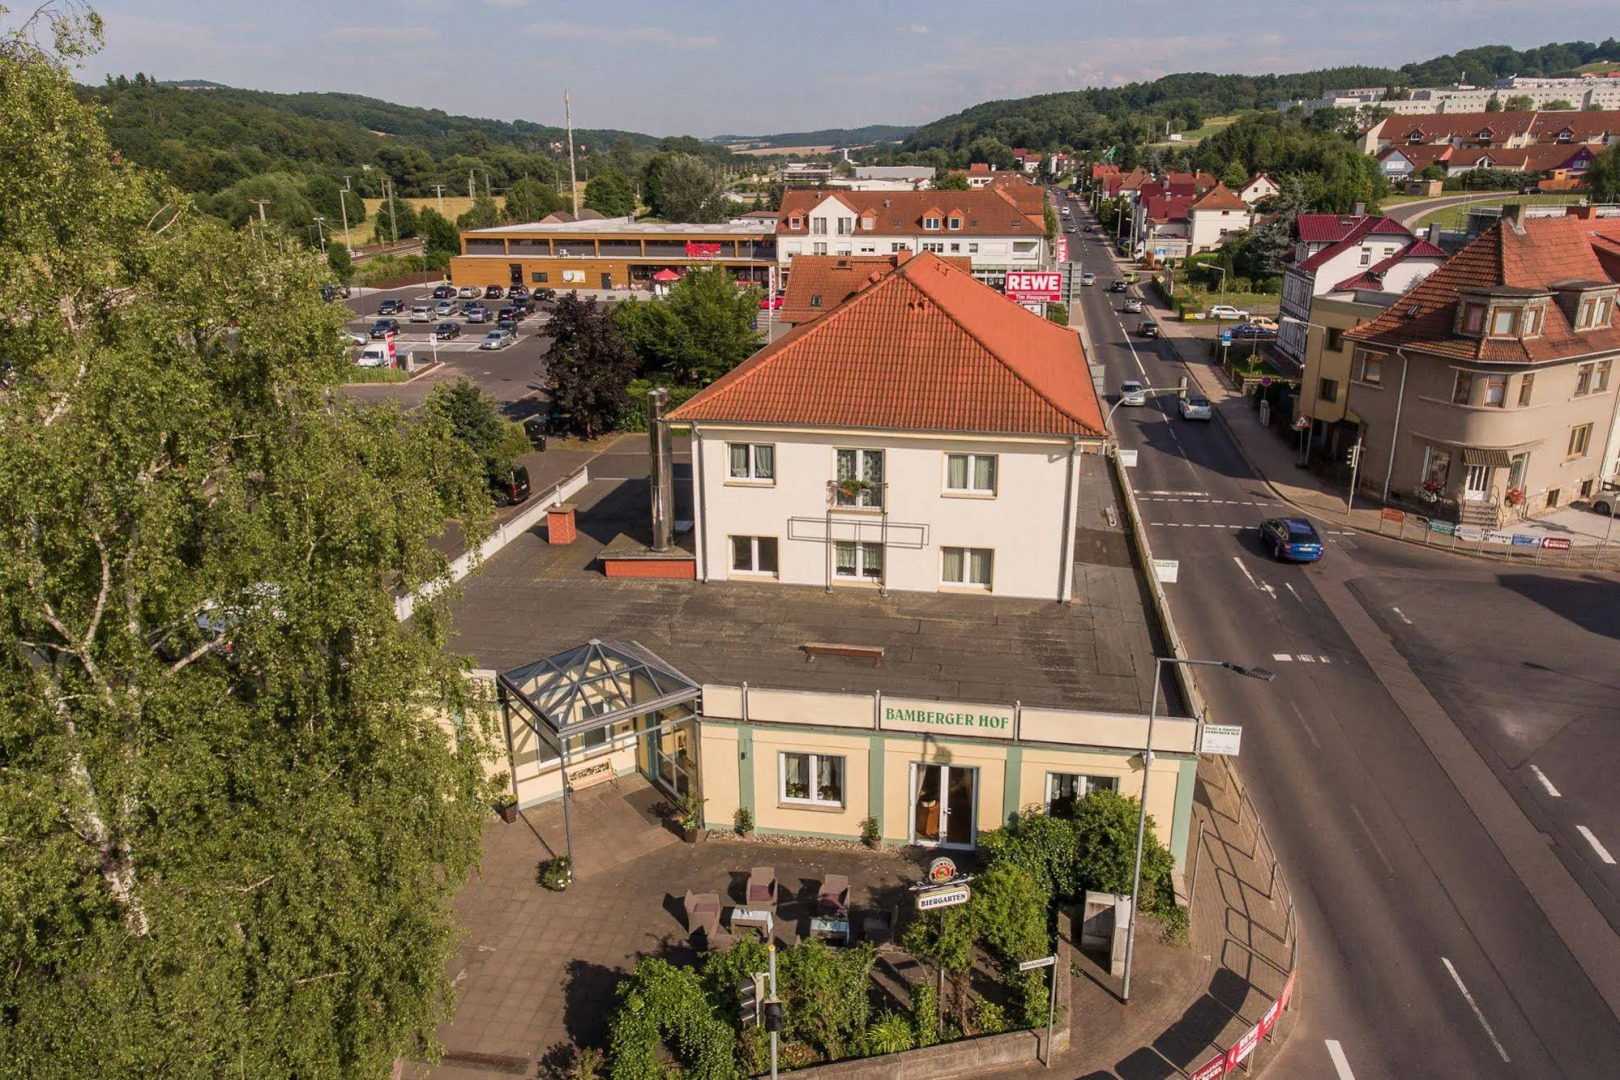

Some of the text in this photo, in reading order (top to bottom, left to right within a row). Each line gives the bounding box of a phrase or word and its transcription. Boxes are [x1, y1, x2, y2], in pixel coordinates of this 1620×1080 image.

[1008, 275, 1060, 291] REWE
[886, 708, 1009, 729] BAMBERGER HOF
[921, 893, 966, 907] BIERGARTEN
